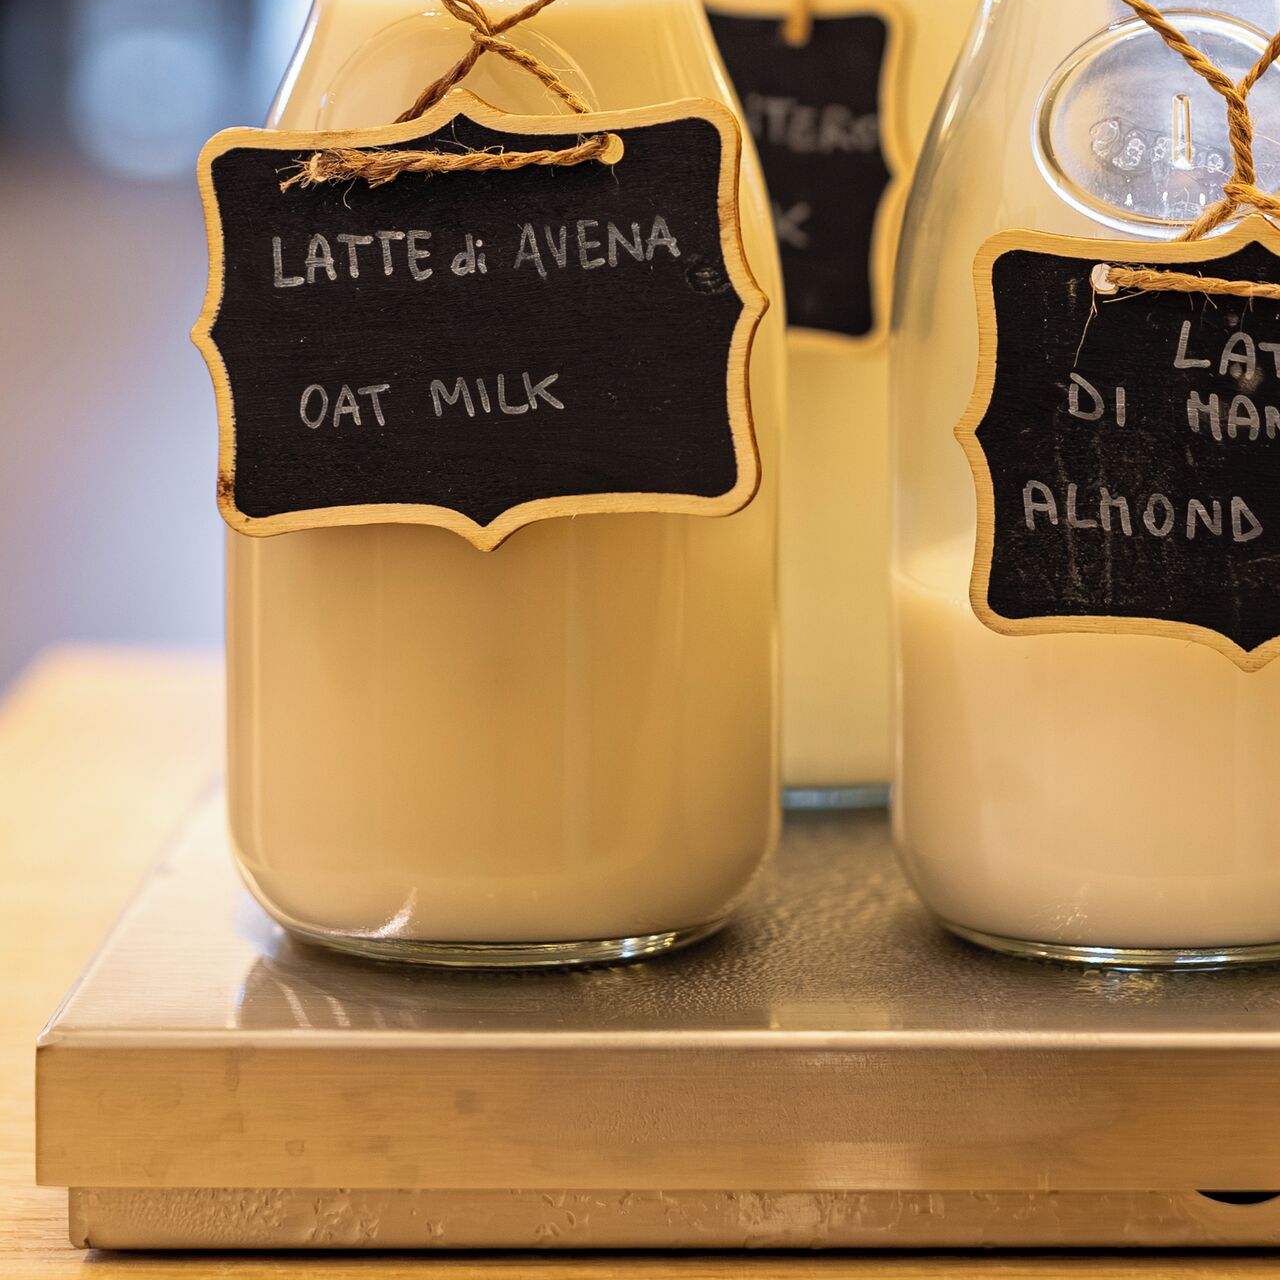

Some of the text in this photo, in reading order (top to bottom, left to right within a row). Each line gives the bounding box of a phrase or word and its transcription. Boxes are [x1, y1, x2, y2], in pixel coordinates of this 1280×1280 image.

[272, 215, 681, 288] LATTE di AVENA
[299, 372, 565, 430] OAT MILK
[1067, 372, 1126, 428] DI
[1022, 479, 1264, 543] ALMOND
